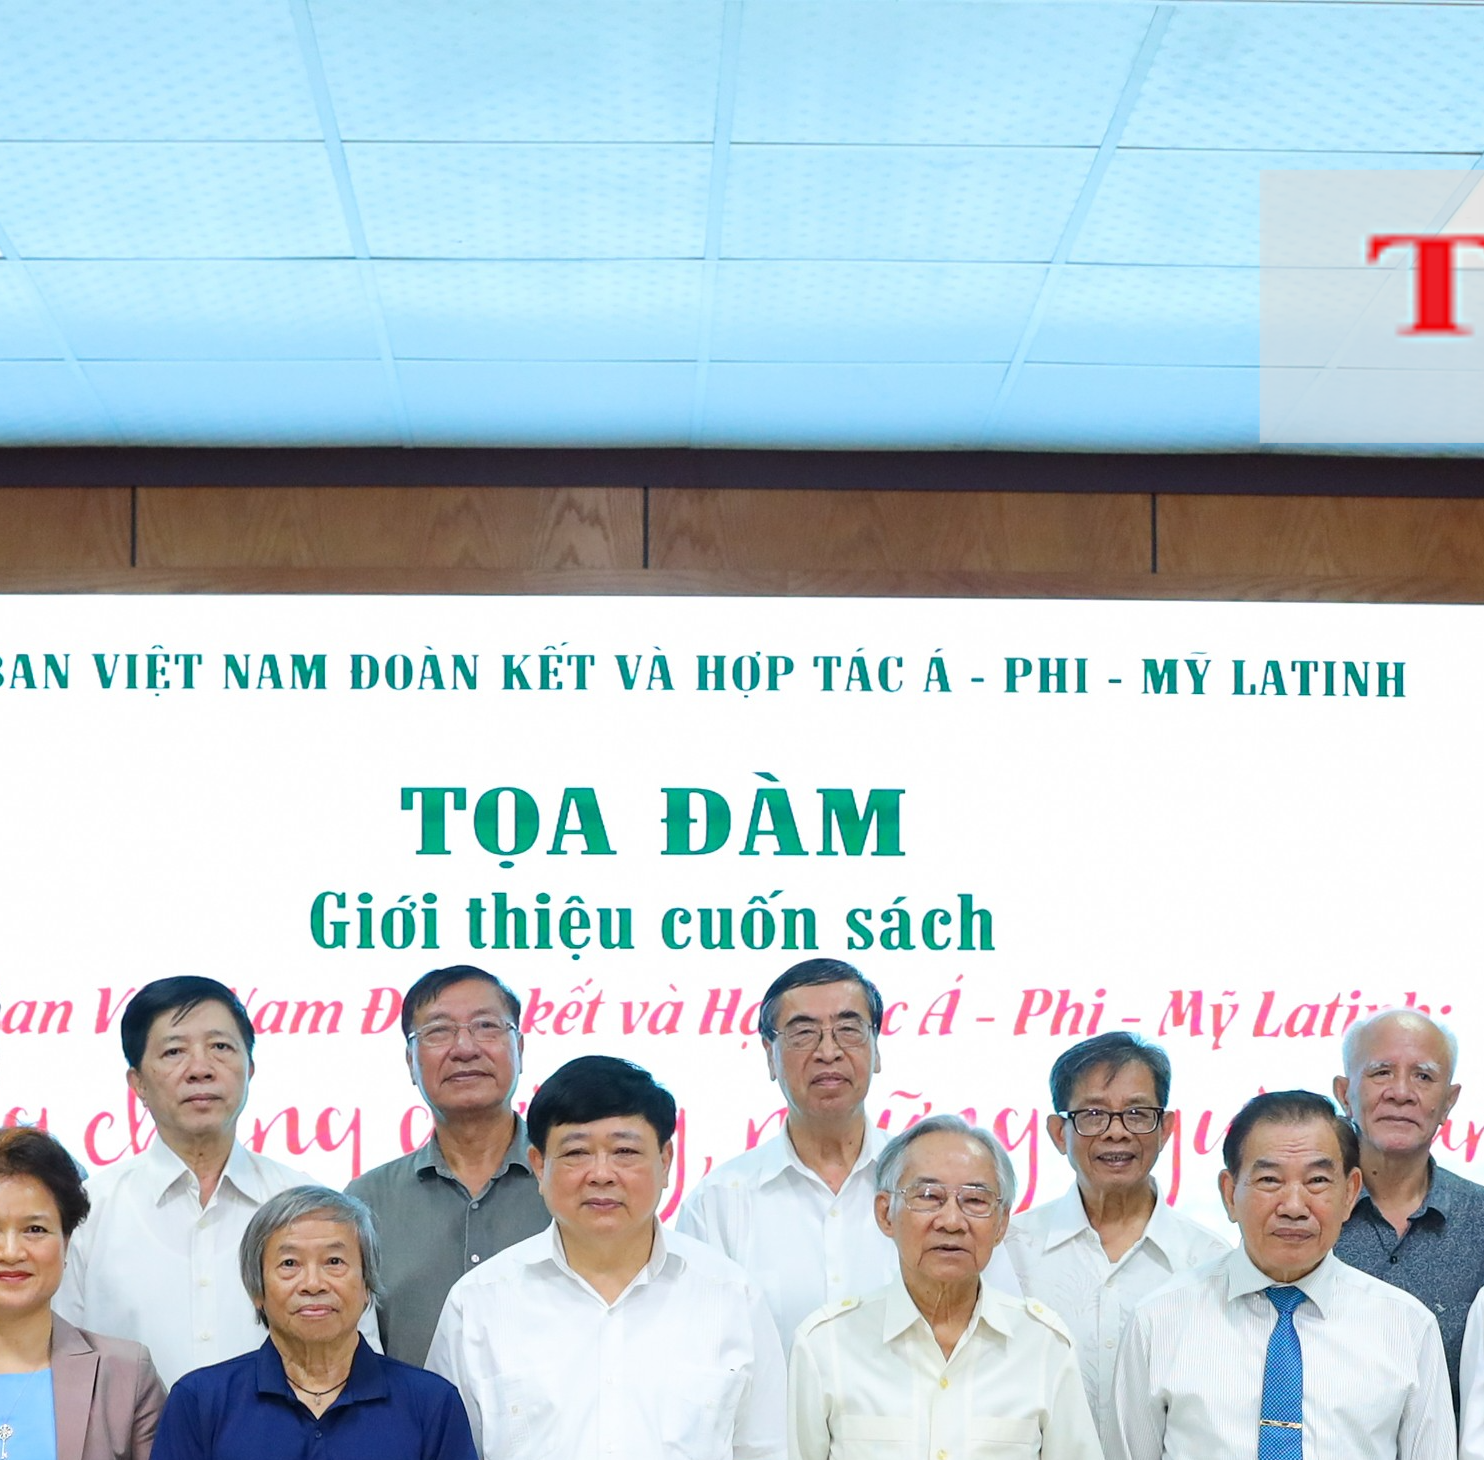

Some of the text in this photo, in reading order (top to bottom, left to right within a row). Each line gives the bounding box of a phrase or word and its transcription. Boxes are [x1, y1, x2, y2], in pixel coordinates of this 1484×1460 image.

[92, 644, 203, 697] VIỆT
[223, 653, 327, 690] NAM
[350, 645, 479, 691] ĐOÀN
[502, 641, 596, 691] KẾT
[614, 646, 675, 691] VÀ
[696, 651, 795, 699] HỢP
[812, 647, 903, 693] TÁC
[923, 648, 952, 693] Á
[1004, 657, 1088, 694] PHI
[1142, 651, 1212, 695] MỸ
[1232, 659, 1406, 698] LATINH
[400, 771, 906, 869] TỌA ĐÀM
[310, 889, 996, 961] Giới thiệu cuốn sách
[0, 1000, 74, 1035] an
[233, 988, 344, 1035] am
[520, 978, 605, 1036] kết
[621, 984, 684, 1036] và
[918, 975, 964, 1036] Á
[1013, 988, 1107, 1037] Phi
[1158, 989, 1240, 1051] Mỹ
